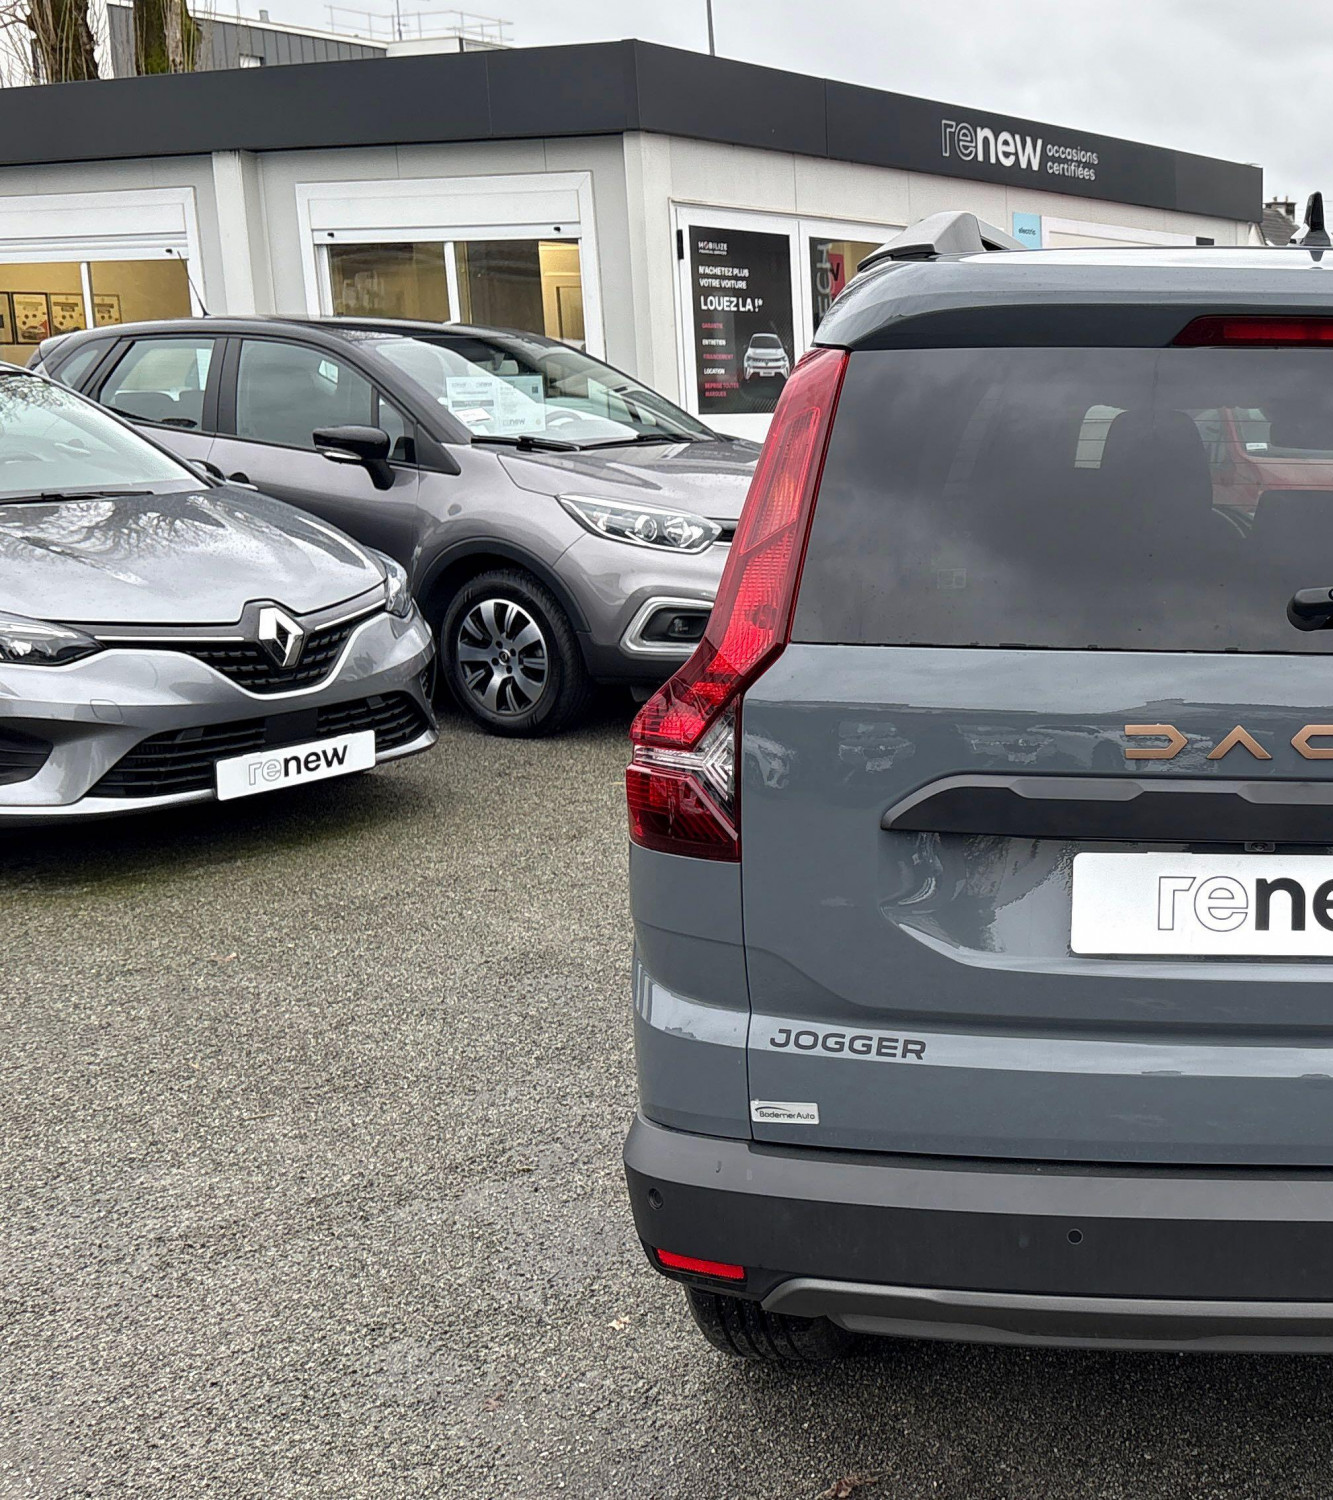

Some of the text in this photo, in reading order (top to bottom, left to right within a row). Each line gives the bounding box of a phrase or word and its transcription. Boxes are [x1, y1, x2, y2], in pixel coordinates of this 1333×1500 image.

[942, 120, 1042, 171] renew
[1046, 144, 1099, 165] occasions
[1047, 161, 1096, 181] certifiées
[698, 241, 728, 251] MOBILIZE
[698, 266, 749, 278] N'ACHETEZ PLUS
[699, 278, 747, 290] VOTRE VOITURE
[700, 295, 737, 311] LOUEZ
[739, 297, 754, 312] LA
[703, 367, 725, 375] LOCATION
[249, 744, 348, 786] renew
[769, 1028, 927, 1061] JOGGER
